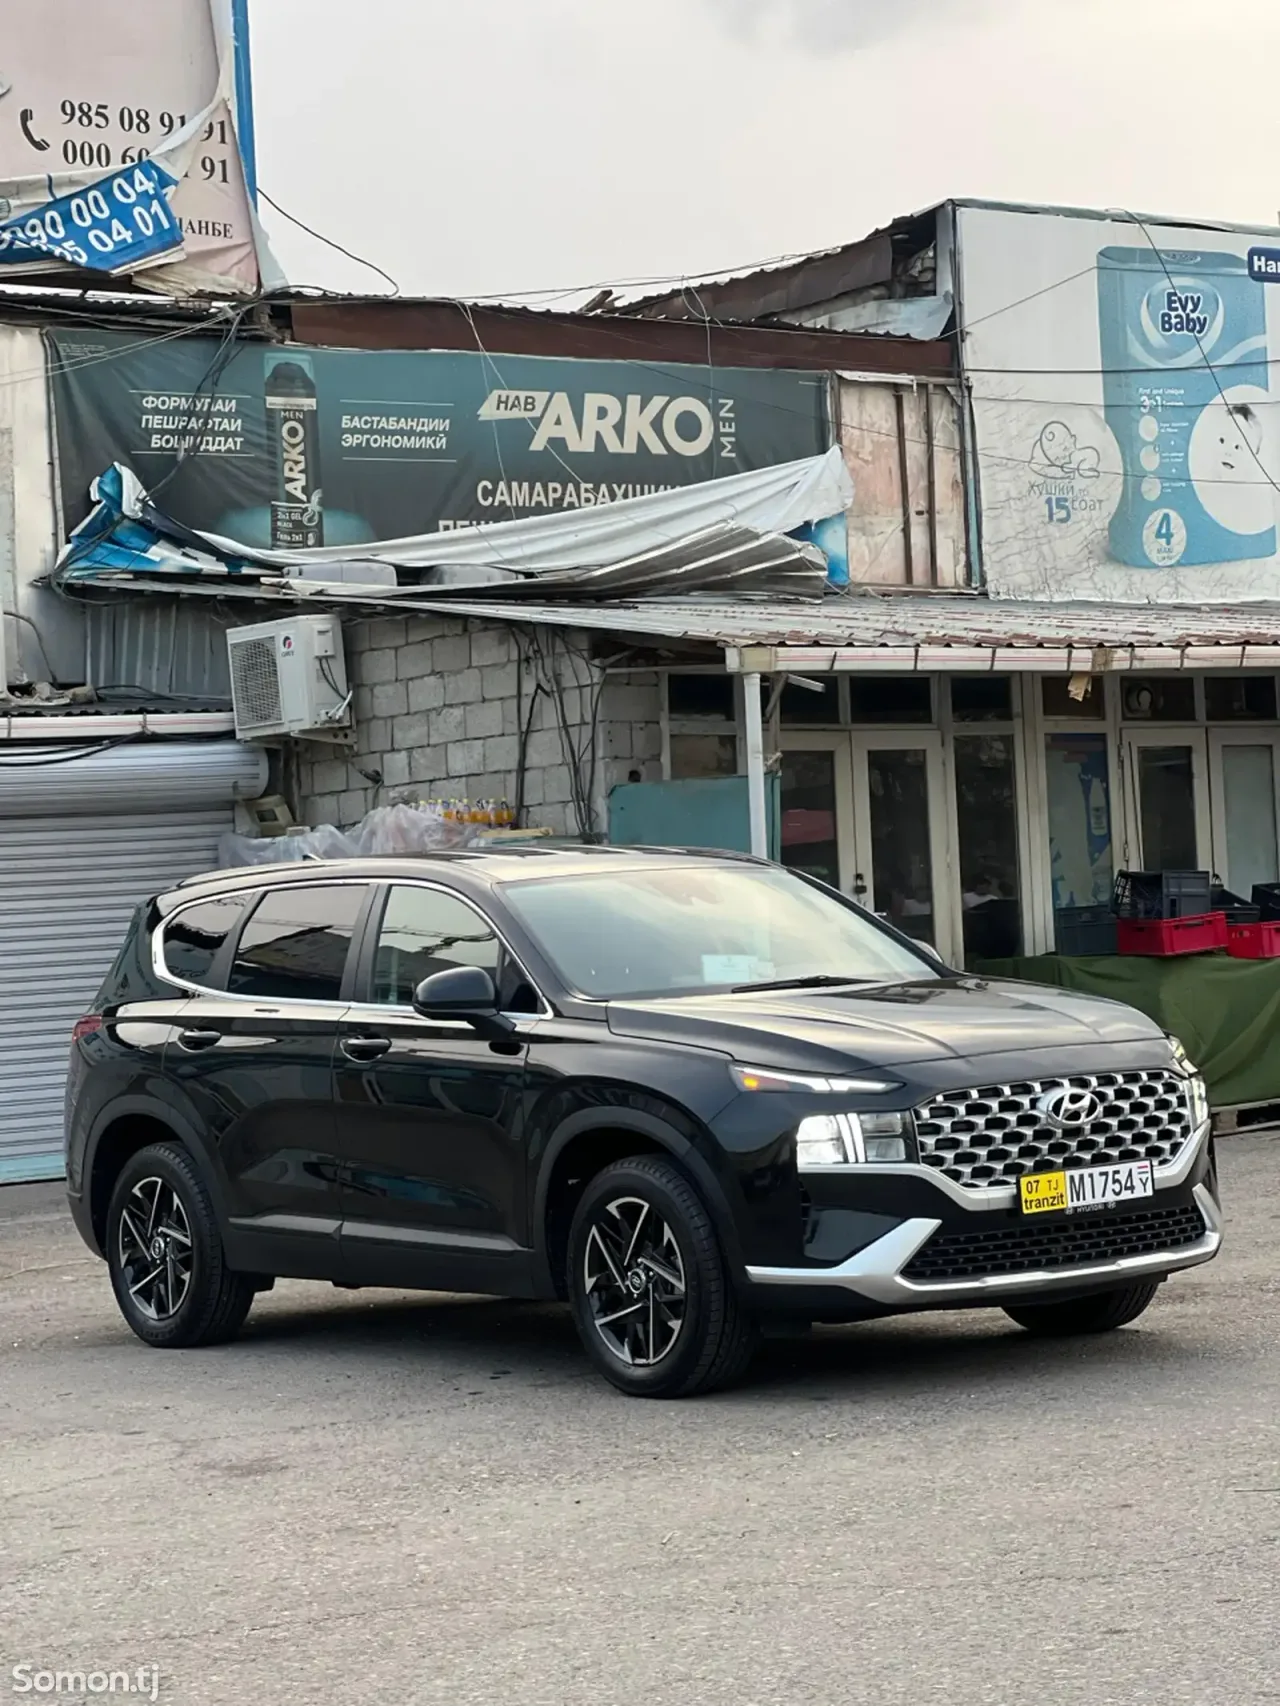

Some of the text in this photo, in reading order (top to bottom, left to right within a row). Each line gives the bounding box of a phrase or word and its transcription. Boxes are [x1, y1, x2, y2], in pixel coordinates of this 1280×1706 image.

[60, 99, 109, 129] 985
[119, 106, 150, 134] 08
[62, 139, 111, 168] 000
[201, 156, 230, 184] 91
[70, 190, 111, 227] 00
[113, 168, 155, 204] 04
[88, 218, 133, 252] 04
[133, 199, 170, 237] 01
[1166, 290, 1202, 313] Evy
[1160, 312, 1208, 334] Baby
[280, 410, 304, 420] MEN
[341, 415, 450, 433] БАСТАБАНДИИ
[528, 391, 714, 457] ARKO
[719, 398, 737, 458] MEN
[281, 420, 307, 502] ARKO
[1044, 496, 1072, 524] 15
[1155, 512, 1175, 546] 4
[1024, 1192, 1065, 1211] tranzit
[1026, 1178, 1059, 1195] 07 TJ
[1068, 1167, 1136, 1203] M1754
